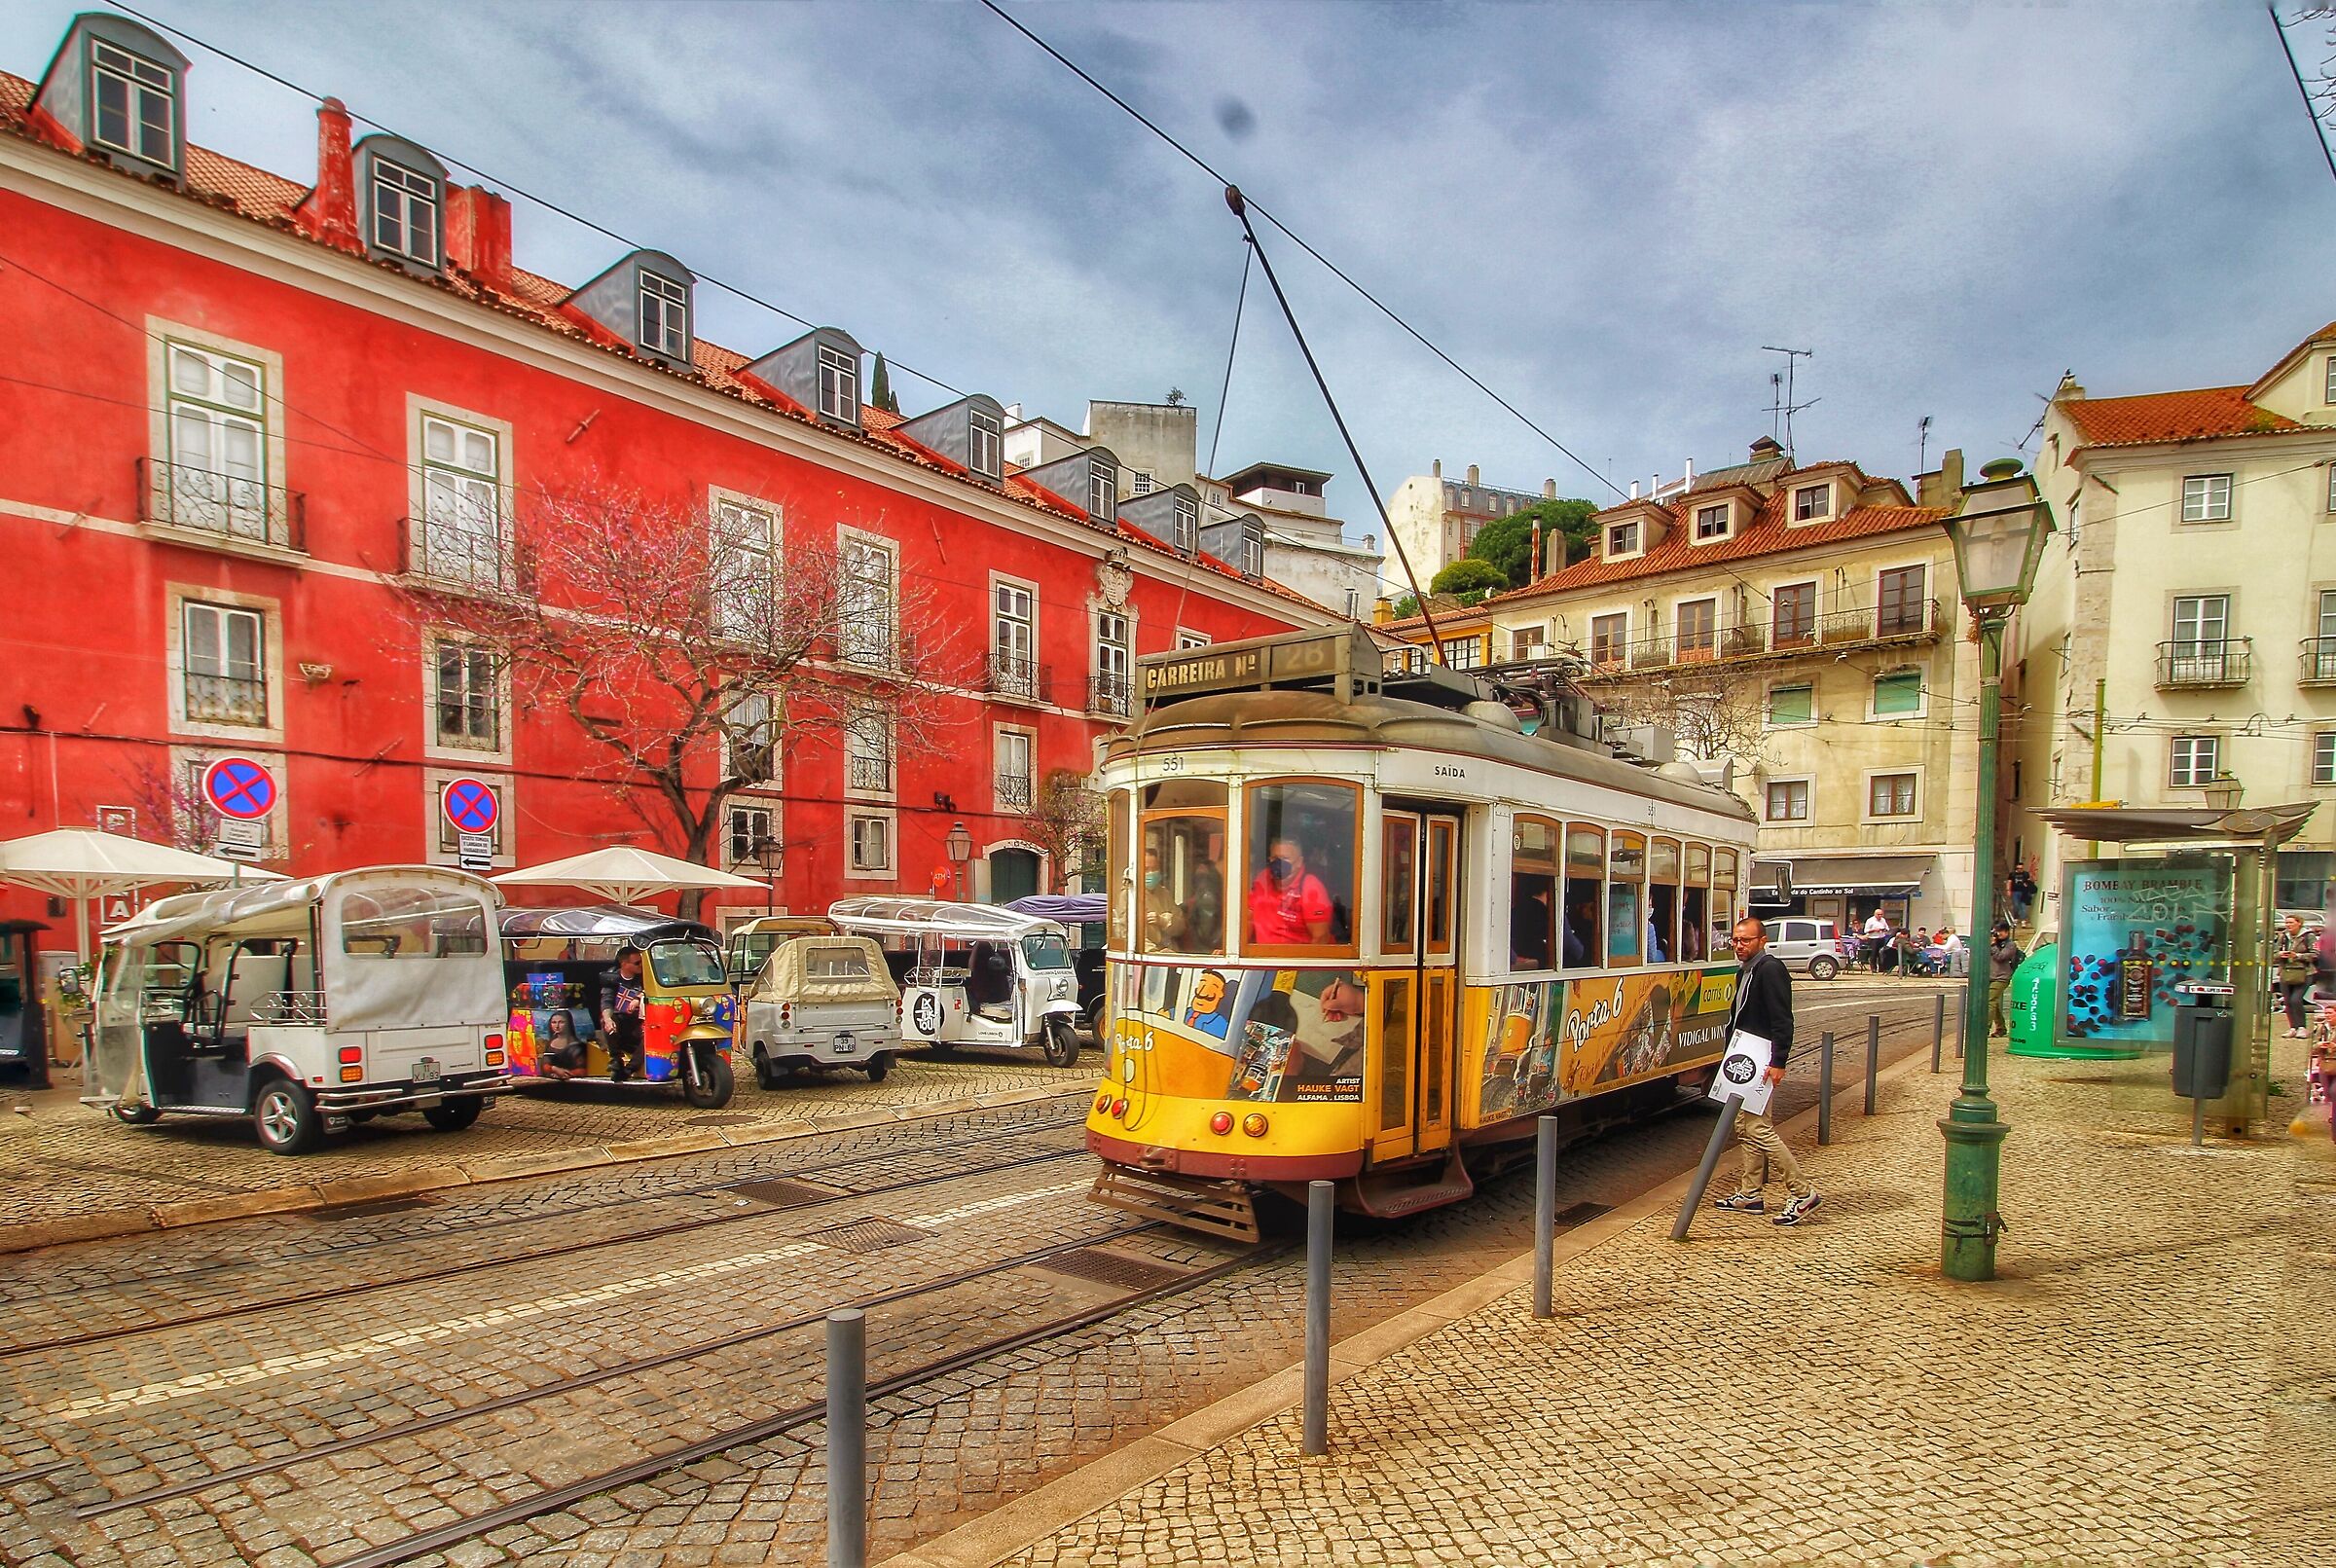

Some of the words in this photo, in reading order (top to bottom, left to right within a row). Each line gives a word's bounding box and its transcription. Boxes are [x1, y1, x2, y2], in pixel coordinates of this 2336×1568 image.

[1286, 641, 1325, 671] 28
[1147, 659, 1225, 689] CARREIRA
[1235, 654, 1256, 677] Nº
[1163, 756, 1184, 771] 551
[2082, 904, 2110, 913] Sabor
[1703, 983, 1721, 1002] carris
[1567, 1009, 1611, 1053] Porta
[1612, 975, 1624, 1018] 6
[1145, 1030, 1154, 1051] 6
[1678, 1027, 1709, 1048] VIDIGAL
